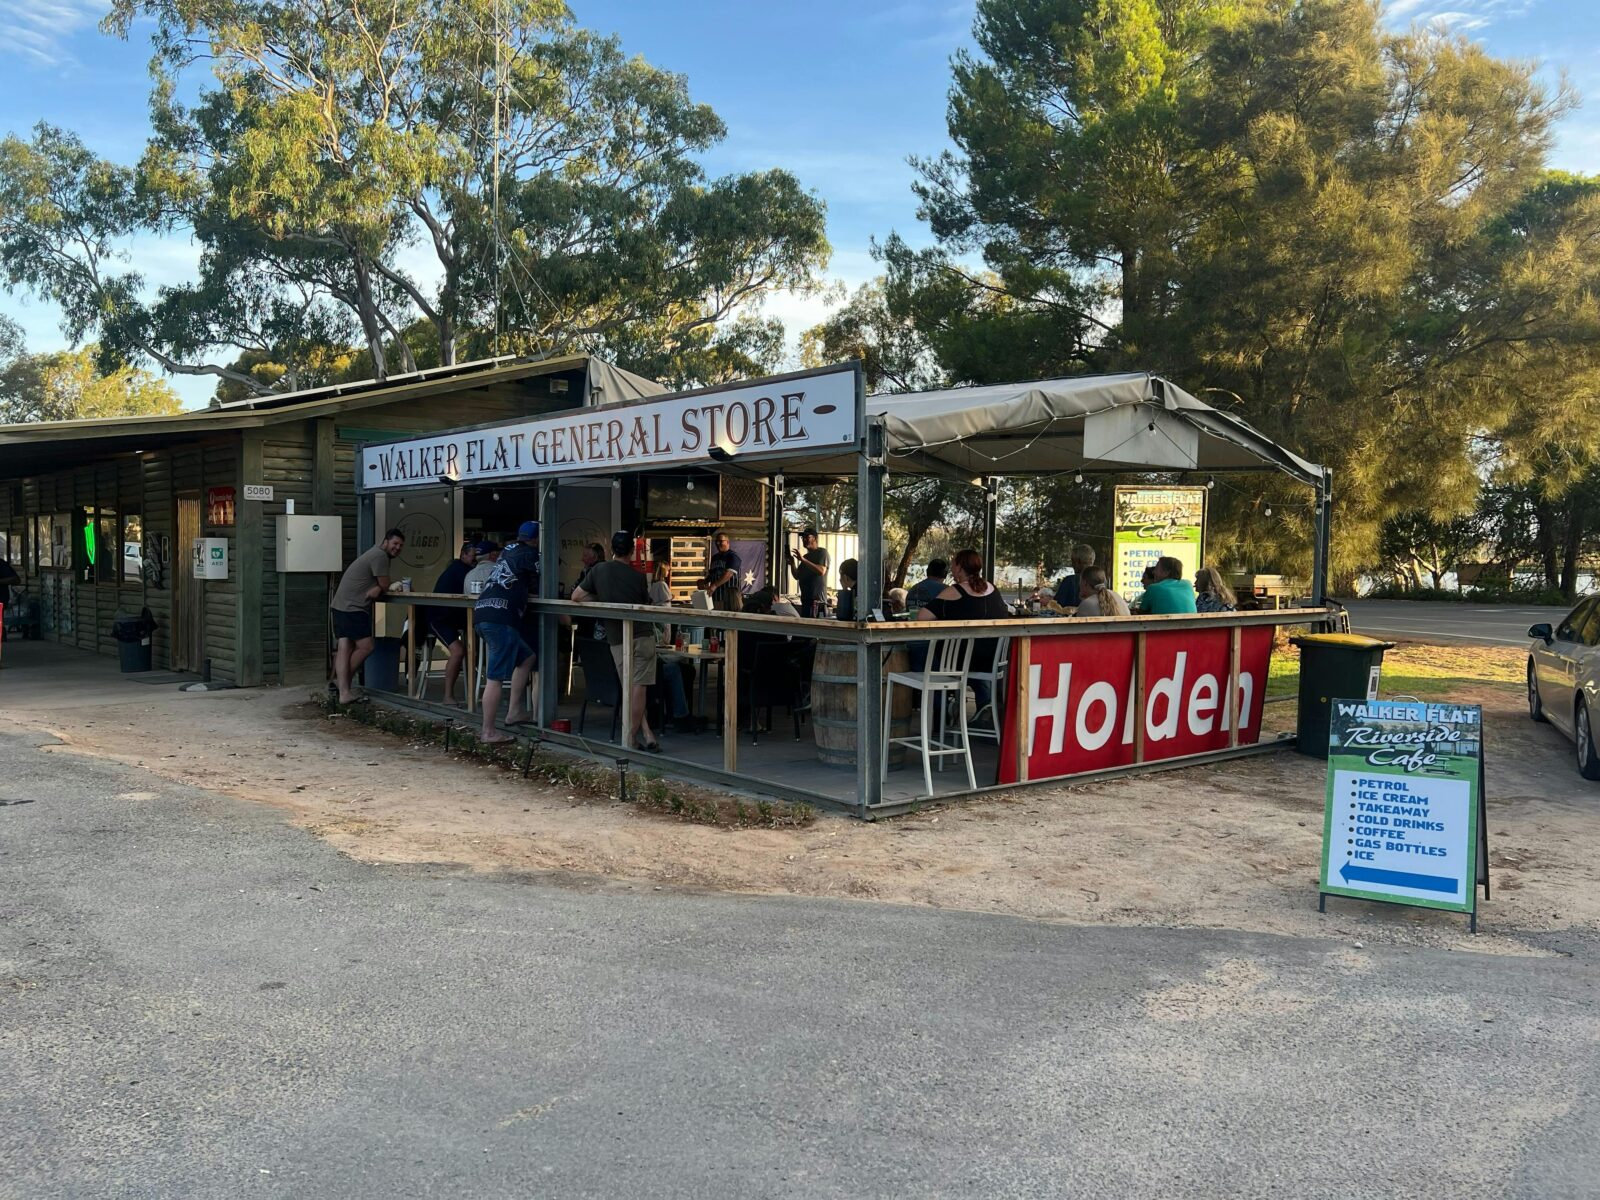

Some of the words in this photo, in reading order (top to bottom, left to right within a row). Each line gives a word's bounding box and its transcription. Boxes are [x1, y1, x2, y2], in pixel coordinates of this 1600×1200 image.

[378, 443, 460, 482] WALKER
[466, 433, 525, 473] FLAT
[532, 413, 672, 467] GENERAL
[681, 391, 808, 452] STORE
[247, 486, 270, 496] 5080
[1119, 493, 1168, 504] WALKER
[1122, 507, 1192, 526] Riverside
[1138, 522, 1178, 540] Cafe
[1338, 703, 1420, 722] WALKER
[1426, 708, 1477, 724] FLAT
[1344, 725, 1461, 747] Riverside
[1369, 749, 1437, 772] Cafe
[1358, 778, 1410, 791] PETROL
[1358, 791, 1378, 801] ICE
[1383, 793, 1429, 805] CREAM
[1357, 802, 1430, 817] TAKEAWAY
[1356, 814, 1389, 826] COLD
[1393, 818, 1445, 832] DRINKS
[1356, 826, 1406, 840] COFFEE
[1354, 850, 1375, 861] ICE
[1355, 838, 1381, 849] GAS
[1386, 841, 1447, 857] BOTTLES
